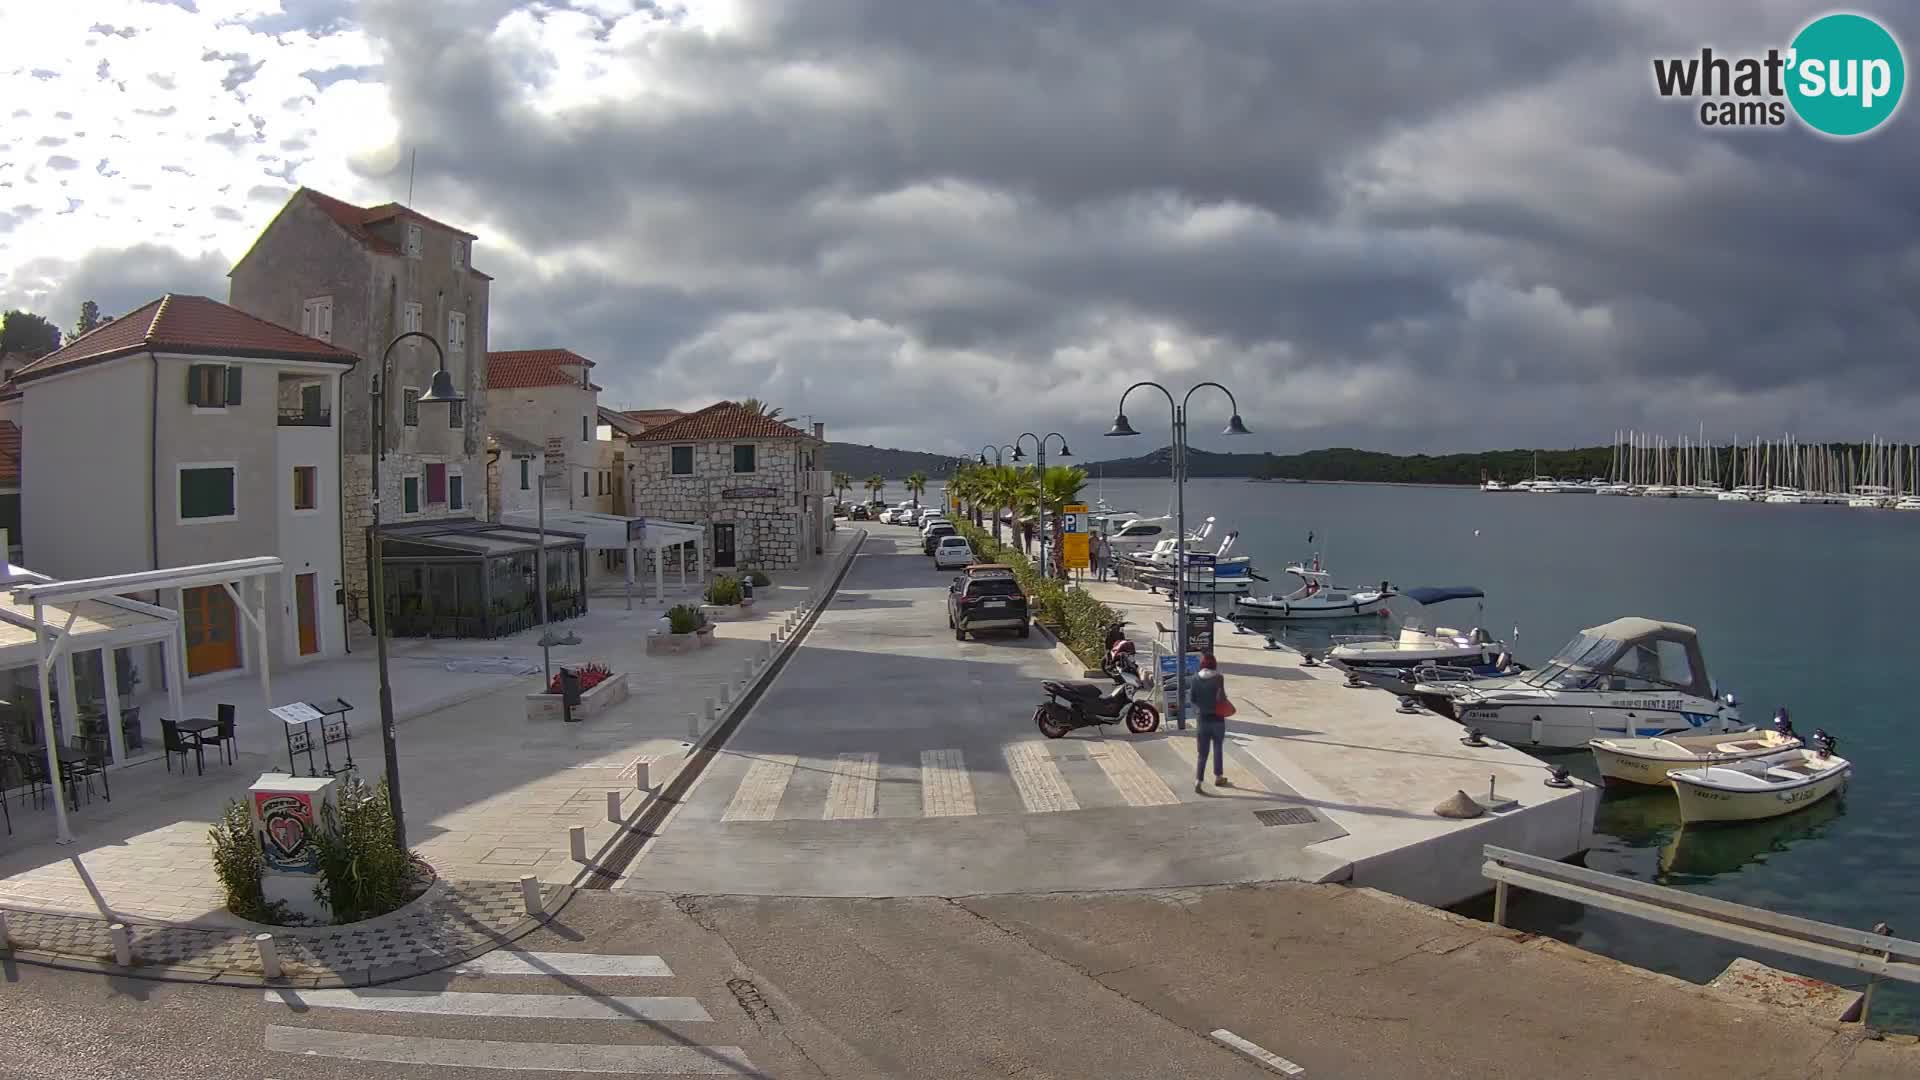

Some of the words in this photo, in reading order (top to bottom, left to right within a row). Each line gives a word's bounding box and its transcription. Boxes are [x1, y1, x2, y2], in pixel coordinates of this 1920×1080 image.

[1066, 515, 1076, 531] P
[1643, 699, 1660, 709] RENT
[1667, 700, 1683, 711] BOAT
